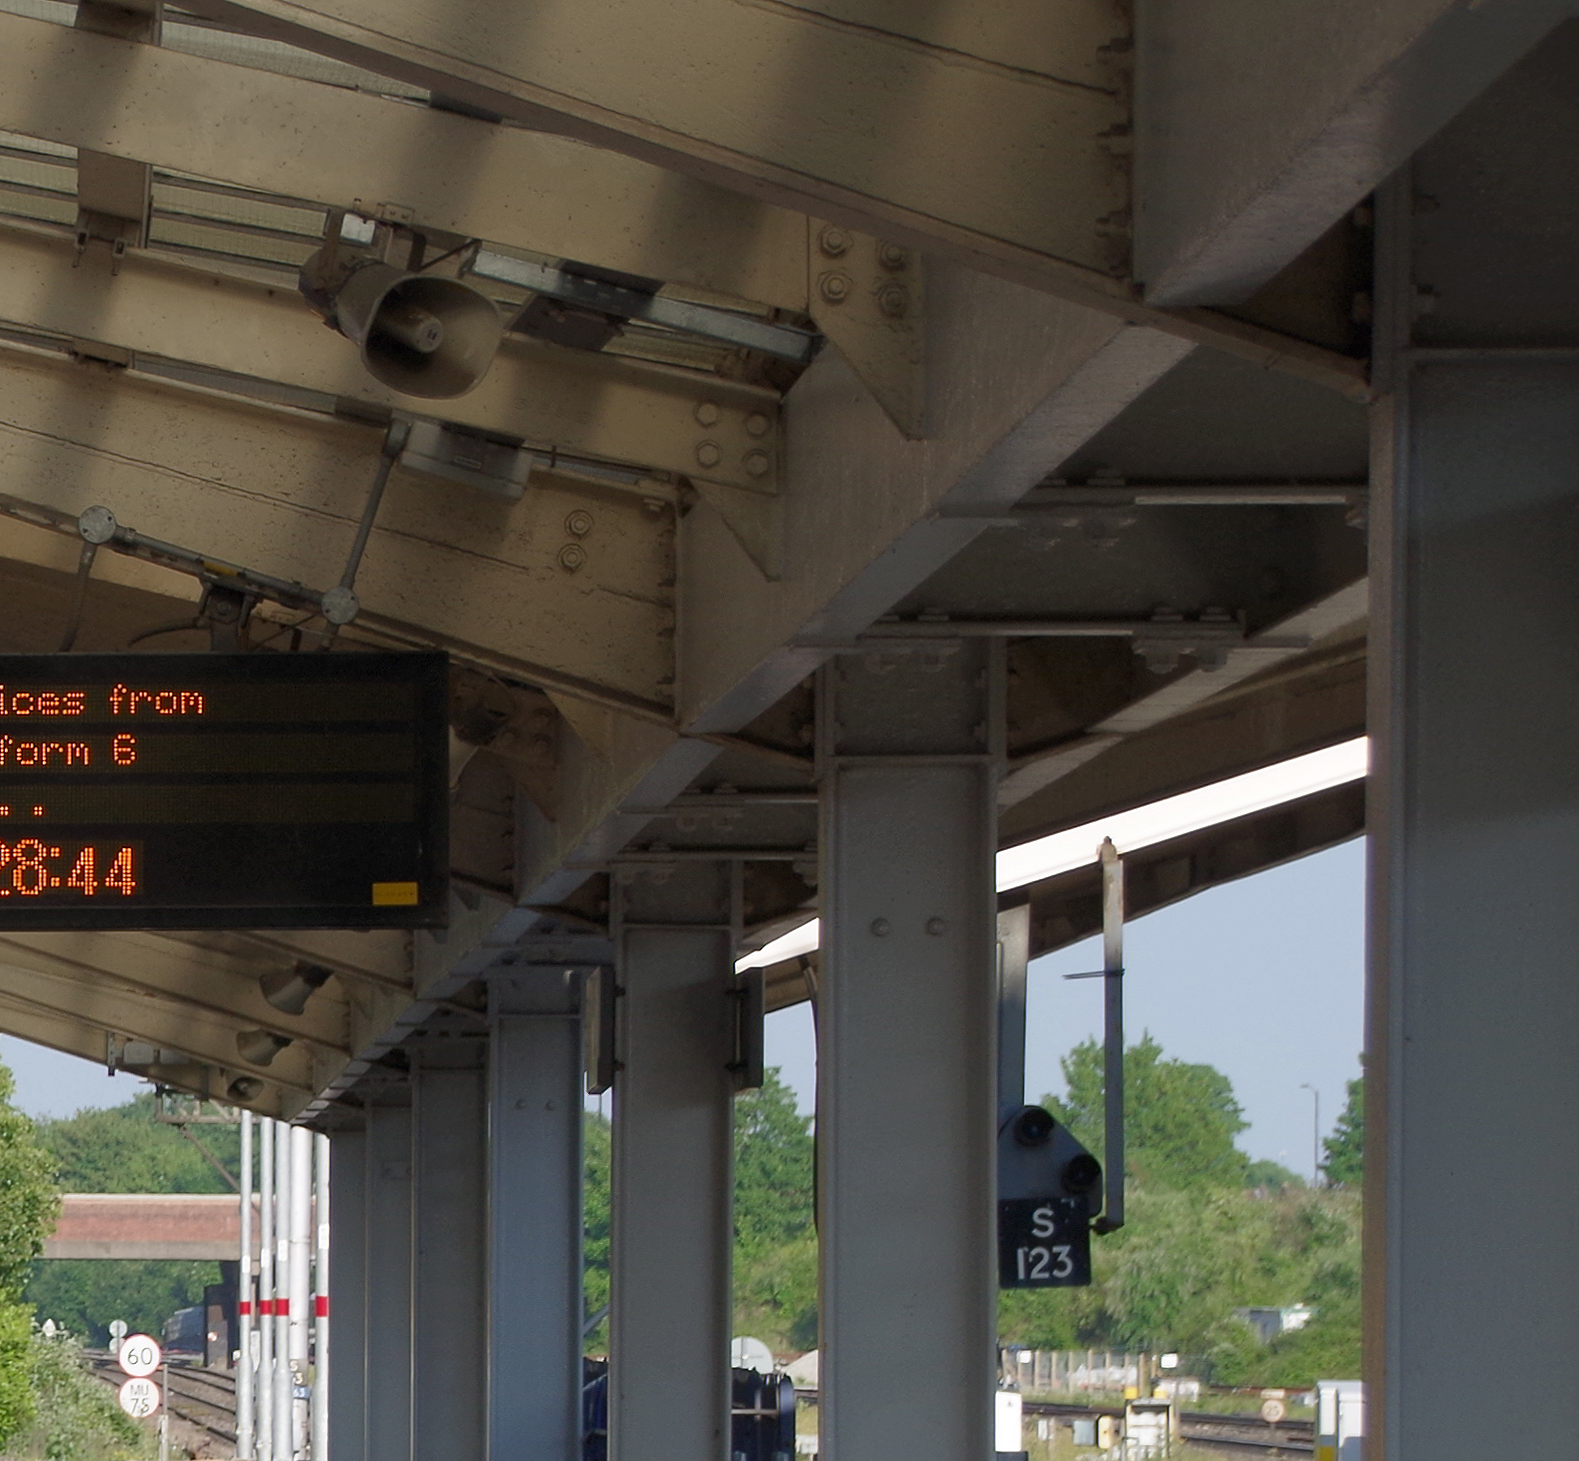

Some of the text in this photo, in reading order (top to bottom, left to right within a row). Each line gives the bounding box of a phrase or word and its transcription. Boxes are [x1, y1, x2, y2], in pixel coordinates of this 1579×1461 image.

[109, 683, 203, 715] from
[113, 733, 136, 765] 6
[1032, 1207, 1055, 1238] S
[1017, 1244, 1073, 1280] 123
[128, 1347, 152, 1365] 60
[130, 1384, 149, 1396] MU
